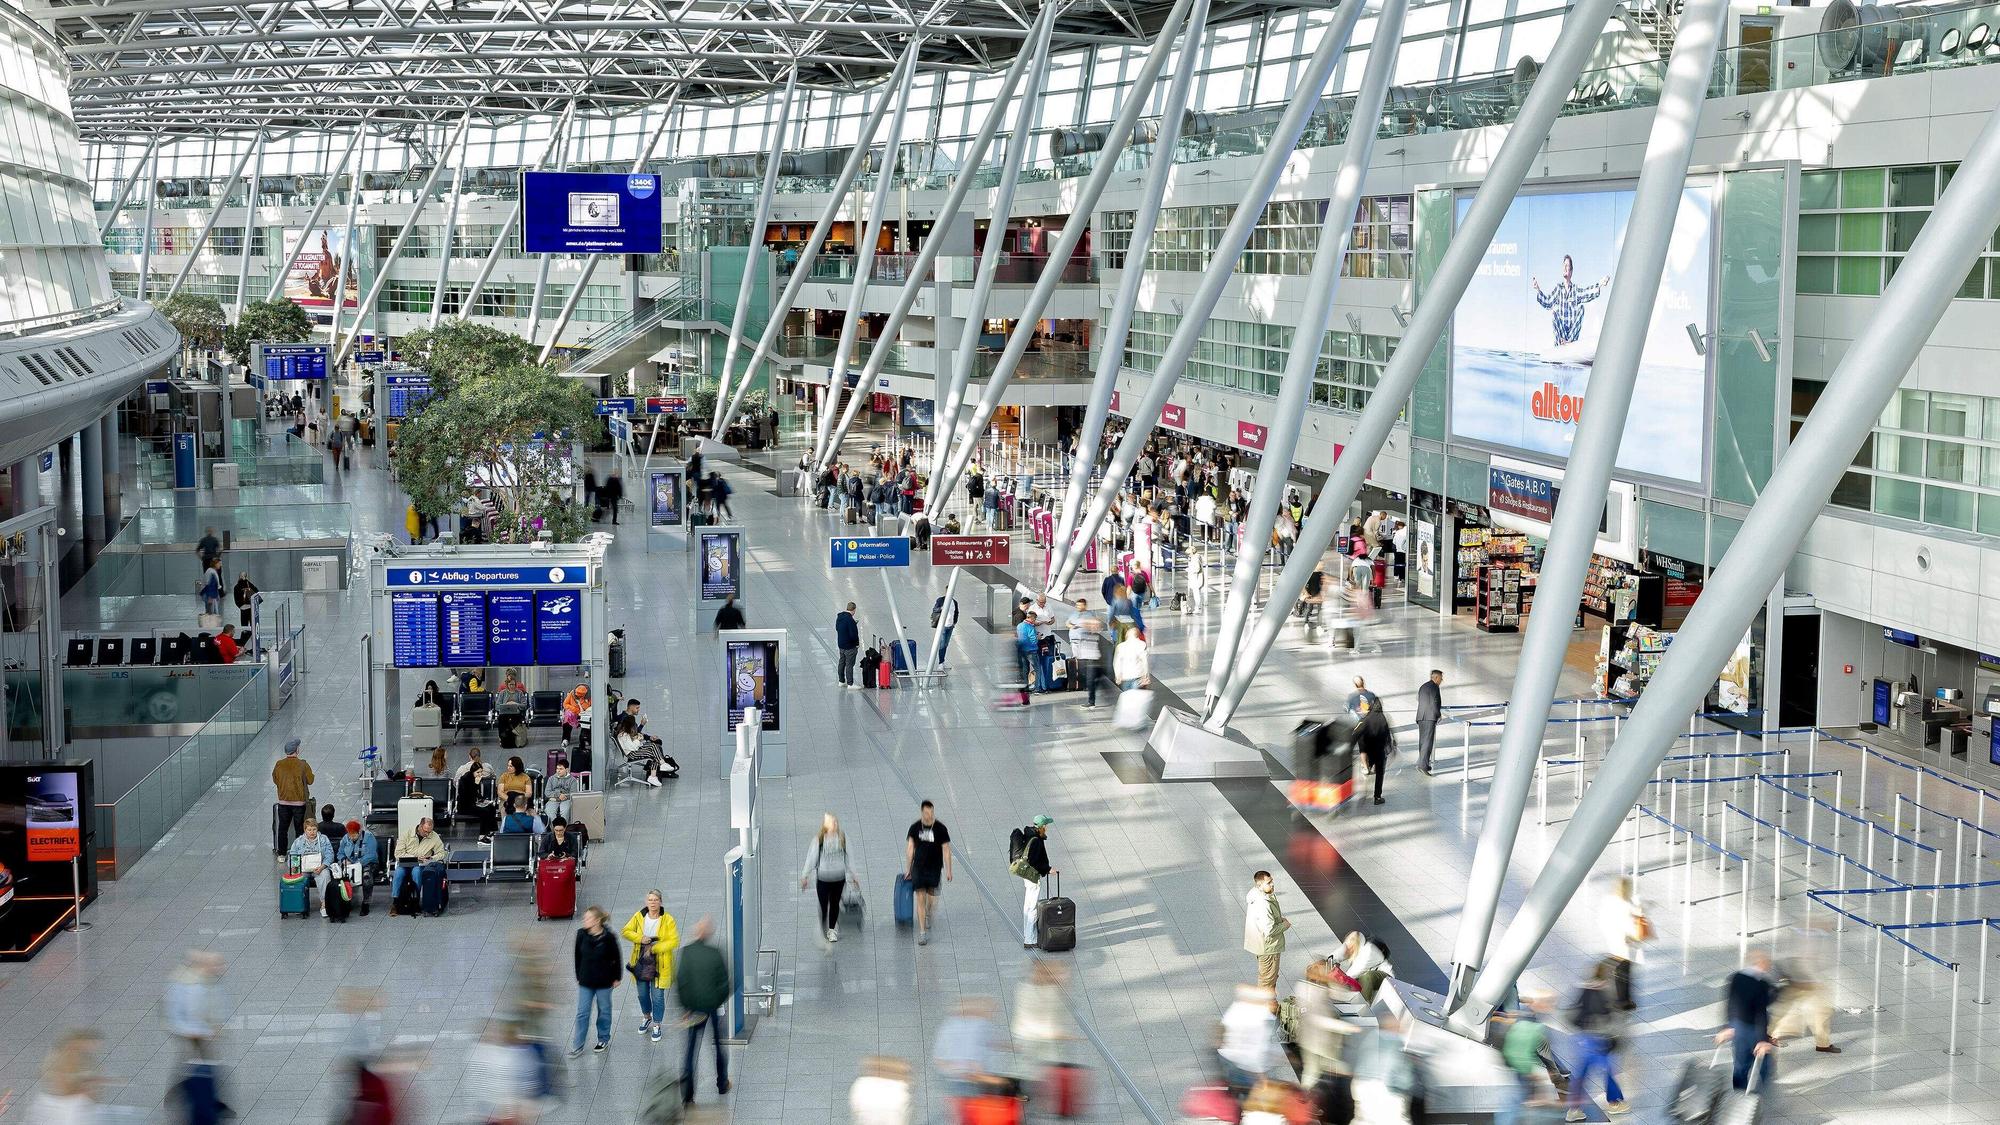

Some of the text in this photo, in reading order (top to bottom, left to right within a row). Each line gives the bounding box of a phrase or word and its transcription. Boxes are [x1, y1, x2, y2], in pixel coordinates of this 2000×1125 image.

[1531, 381, 1584, 425] alltou
[1505, 474, 1546, 496] Gates A,B,C
[1504, 496, 1518, 507] Shops
[1522, 501, 1548, 514] Restaurants
[1656, 555, 1685, 573] WHSmith
[441, 572, 519, 582] Abflug Departures
[1667, 569, 1685, 579] EXPRESS
[30, 837, 77, 845] ELECTRIFLY.
